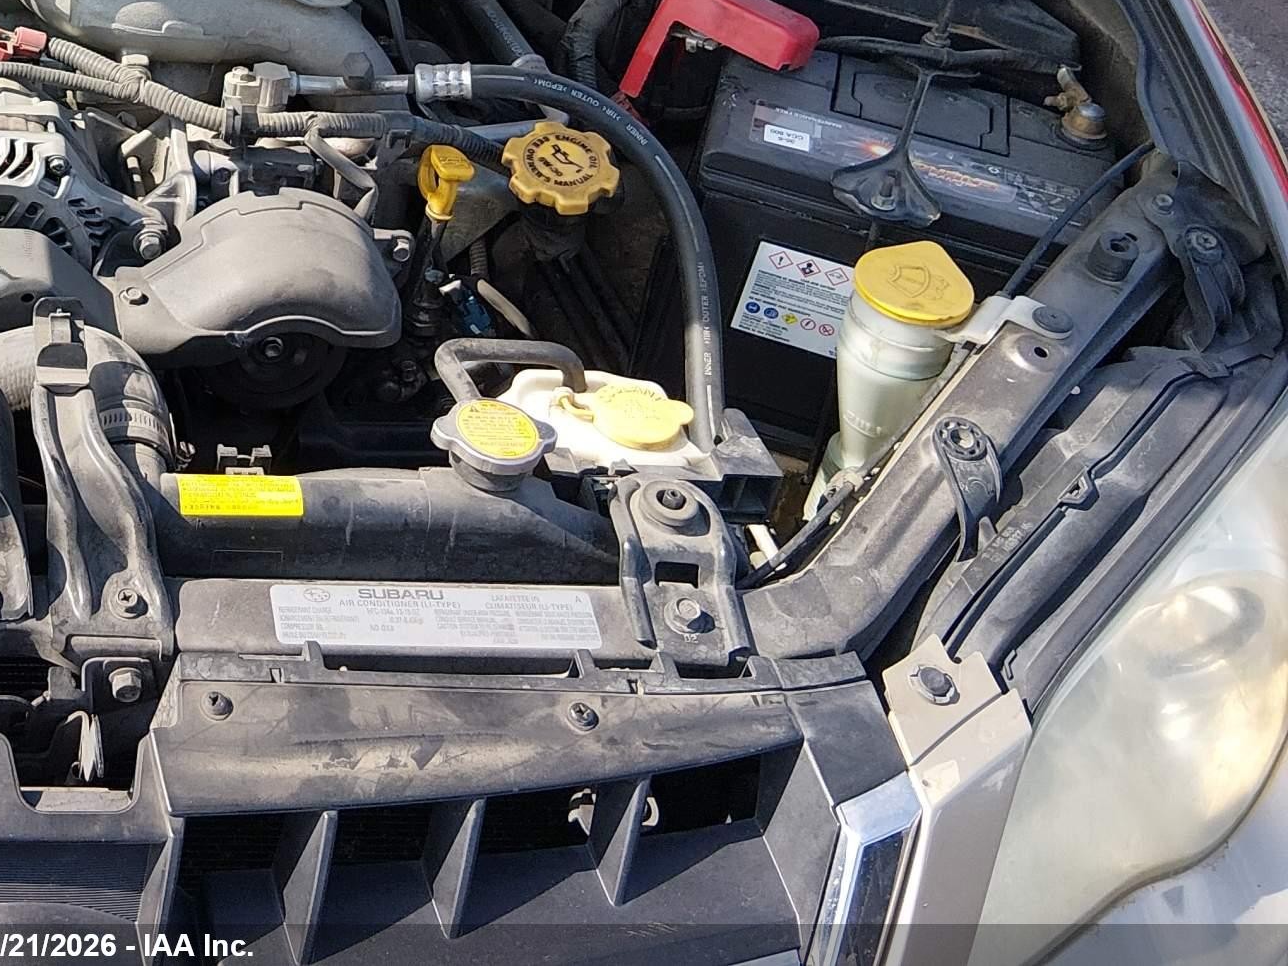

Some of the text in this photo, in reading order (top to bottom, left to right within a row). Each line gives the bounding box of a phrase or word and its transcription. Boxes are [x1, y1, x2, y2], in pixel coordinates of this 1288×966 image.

[570, 88, 600, 107] OUTER
[626, 123, 648, 145] INNER
[532, 136, 549, 147] SEE
[553, 173, 593, 186] MANUAL
[555, 134, 597, 168] ENGINE OIL
[700, 295, 710, 322] OUTER
[357, 600, 419, 608] CONDITIONER
[358, 588, 444, 600] SUBARU
